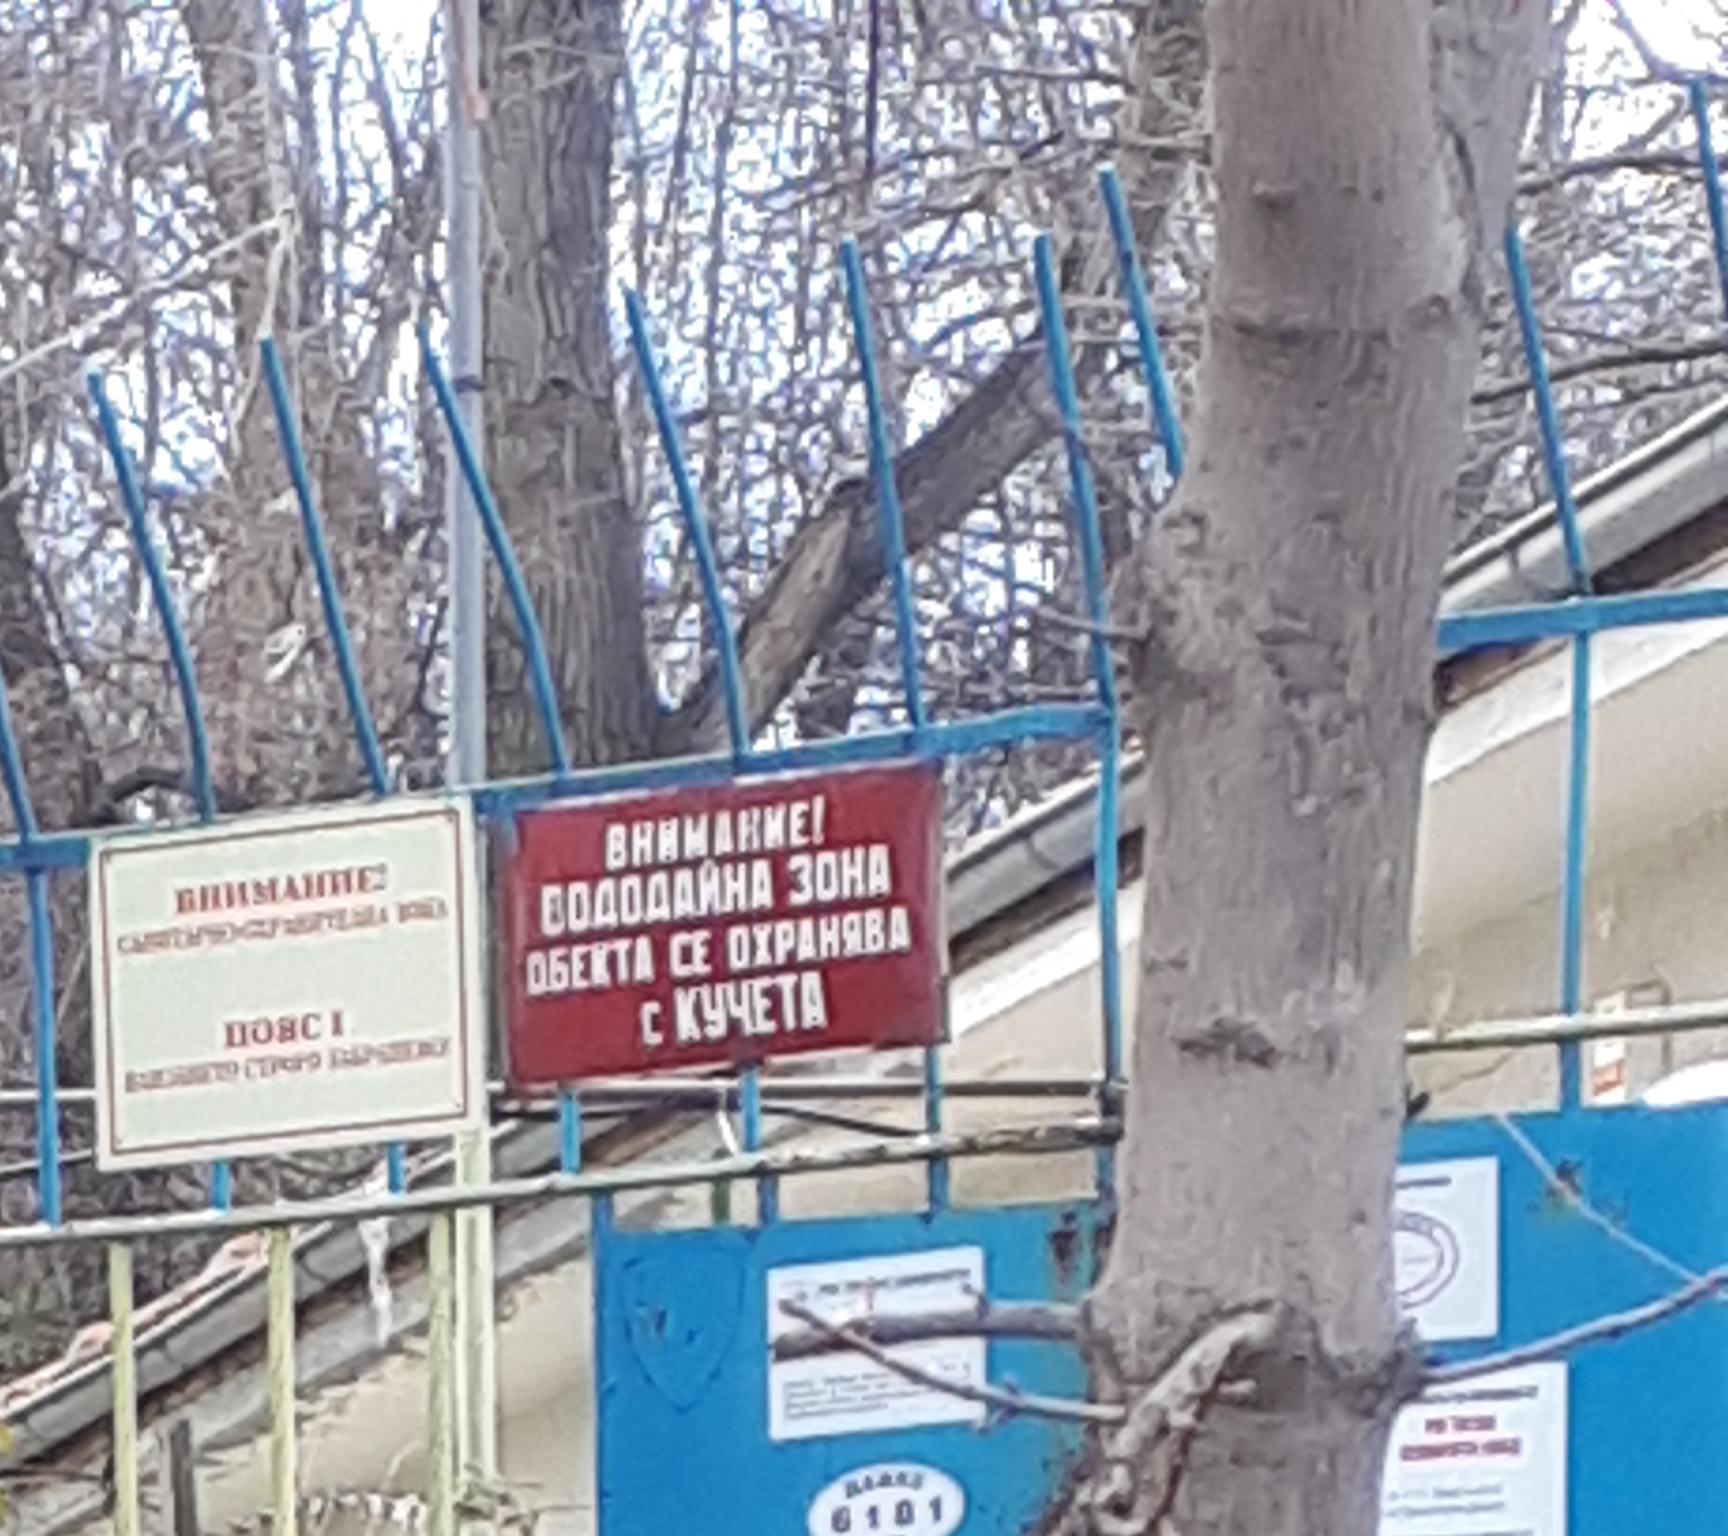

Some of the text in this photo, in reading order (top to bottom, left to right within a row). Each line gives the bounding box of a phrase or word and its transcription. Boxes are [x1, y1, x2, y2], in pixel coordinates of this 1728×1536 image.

[605, 797, 826, 869] ВНИМАНИЕ!
[541, 843, 892, 935] ВОДОДАЙНА ЗОНА
[525, 907, 912, 997] ОБЕКТА СЕ ОХРАНЯВА
[640, 971, 828, 1047] С КУЧЕТА
